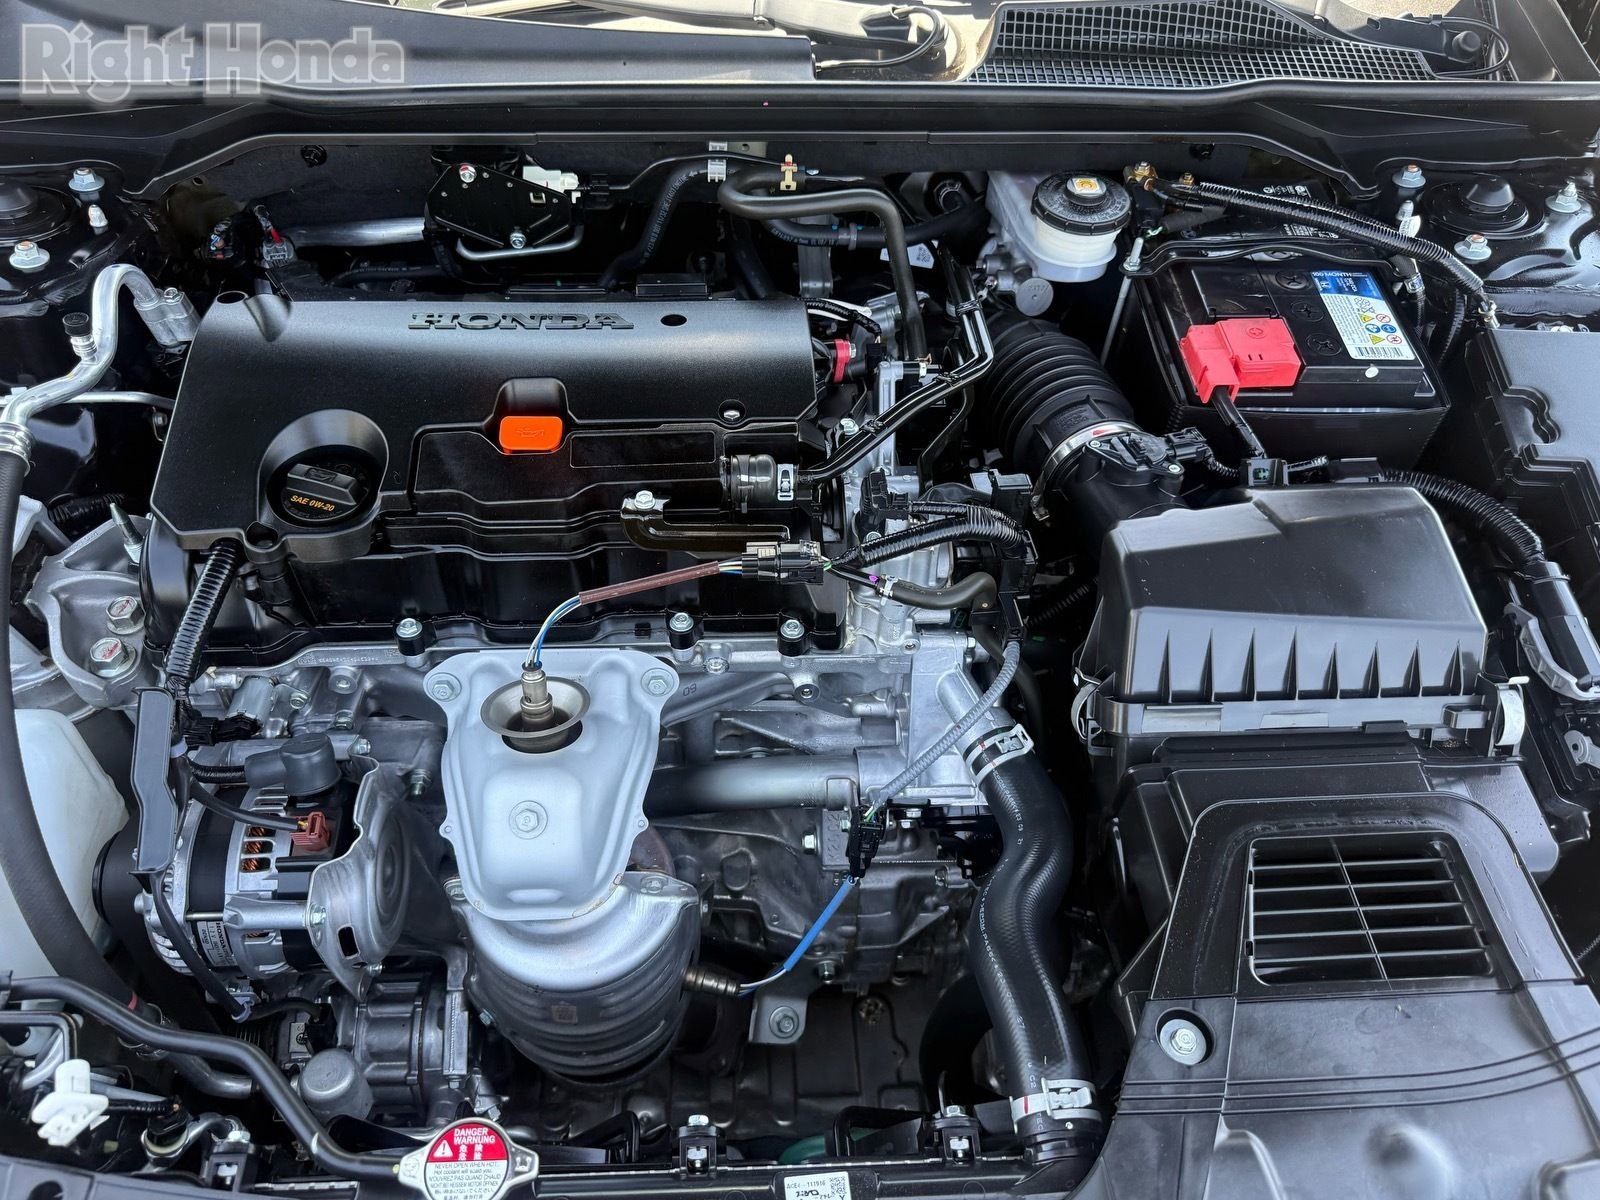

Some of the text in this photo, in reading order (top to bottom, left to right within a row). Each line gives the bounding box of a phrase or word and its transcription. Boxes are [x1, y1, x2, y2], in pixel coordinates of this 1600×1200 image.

[408, 312, 635, 330] HONDA
[290, 495, 310, 505] SAE
[308, 499, 336, 512] 0W-20
[216, 922, 226, 949] HONDA
[454, 1127, 488, 1136] DANGER
[454, 1135, 495, 1145] WARNUNG
